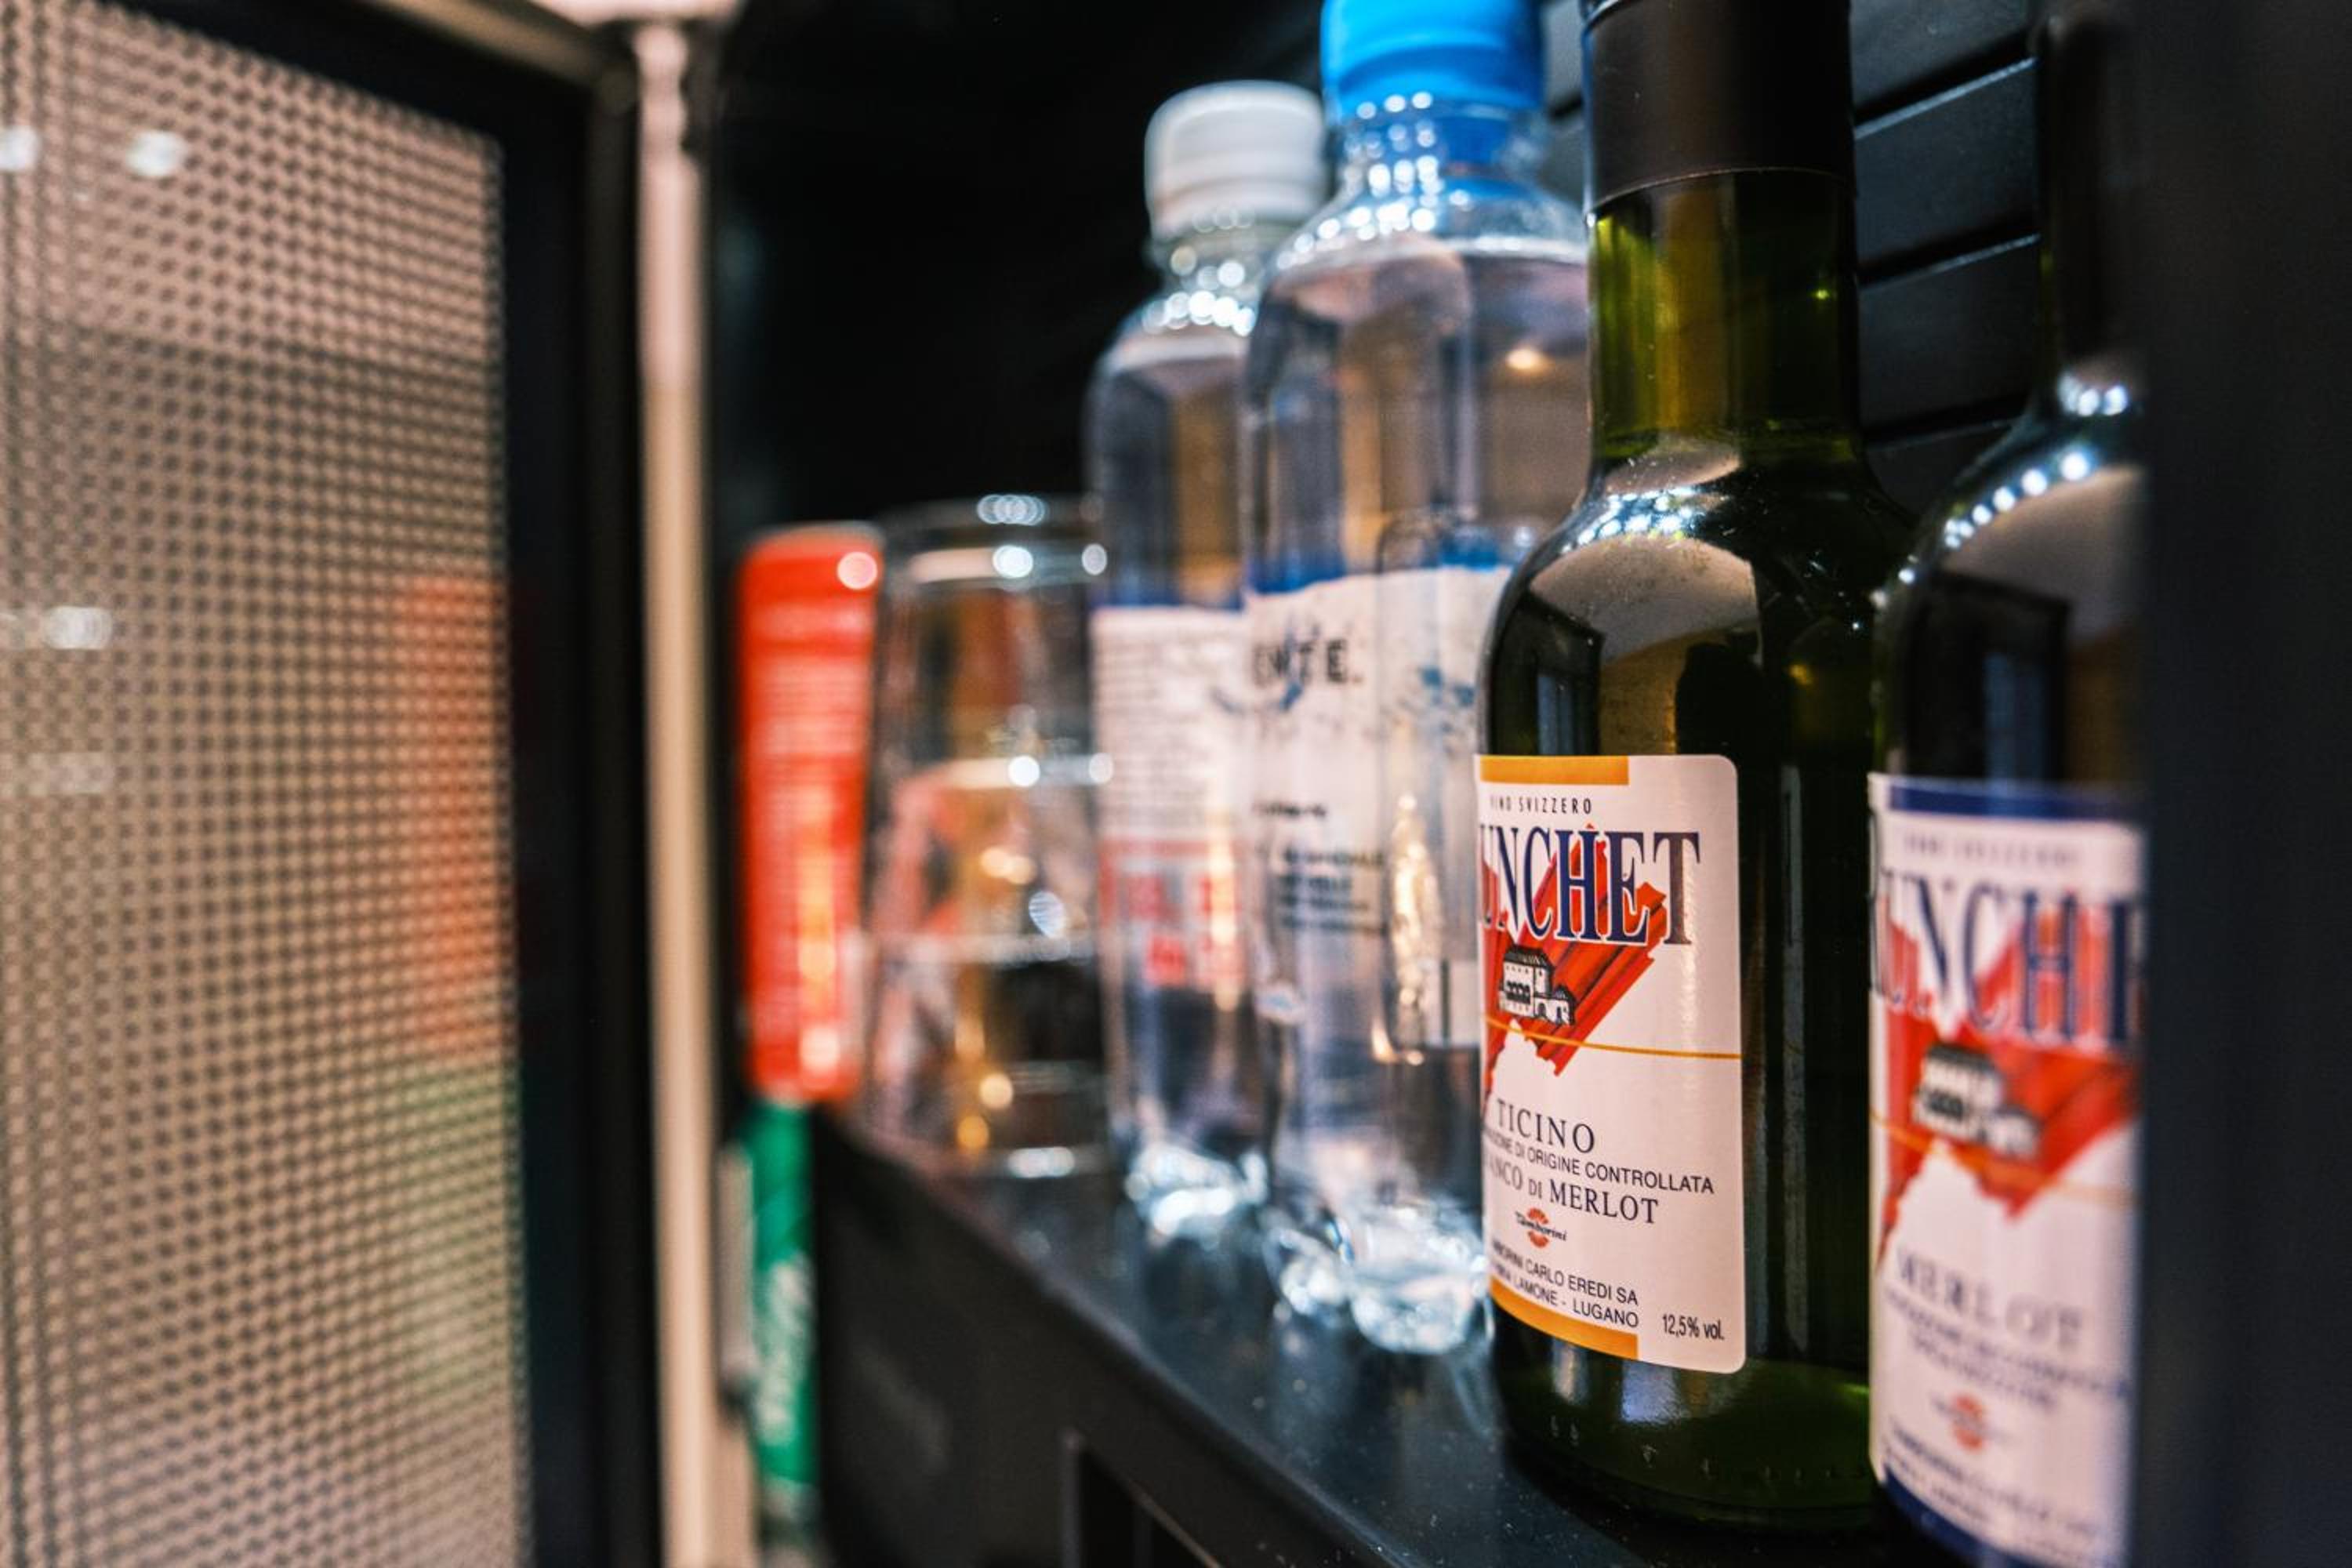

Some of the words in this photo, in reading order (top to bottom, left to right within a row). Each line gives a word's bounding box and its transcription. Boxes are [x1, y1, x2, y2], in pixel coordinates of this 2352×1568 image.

[1519, 796, 1592, 815] SVIZZERO
[1497, 1098, 1595, 1153] TICINO
[1526, 1146, 1581, 1176] ORIGINE
[1585, 1161, 1715, 1194] CONTROLLATA
[1528, 1178, 1543, 1200] DI
[1550, 1178, 1659, 1224] MERLOT
[1526, 1258, 1565, 1287] CARLO
[1568, 1274, 1612, 1300] EREDI
[1616, 1287, 1639, 1306] SA
[1573, 1298, 1639, 1328] LUGANO
[1662, 1313, 1700, 1338] 12,5%
[1704, 1319, 1725, 1340] vol.
